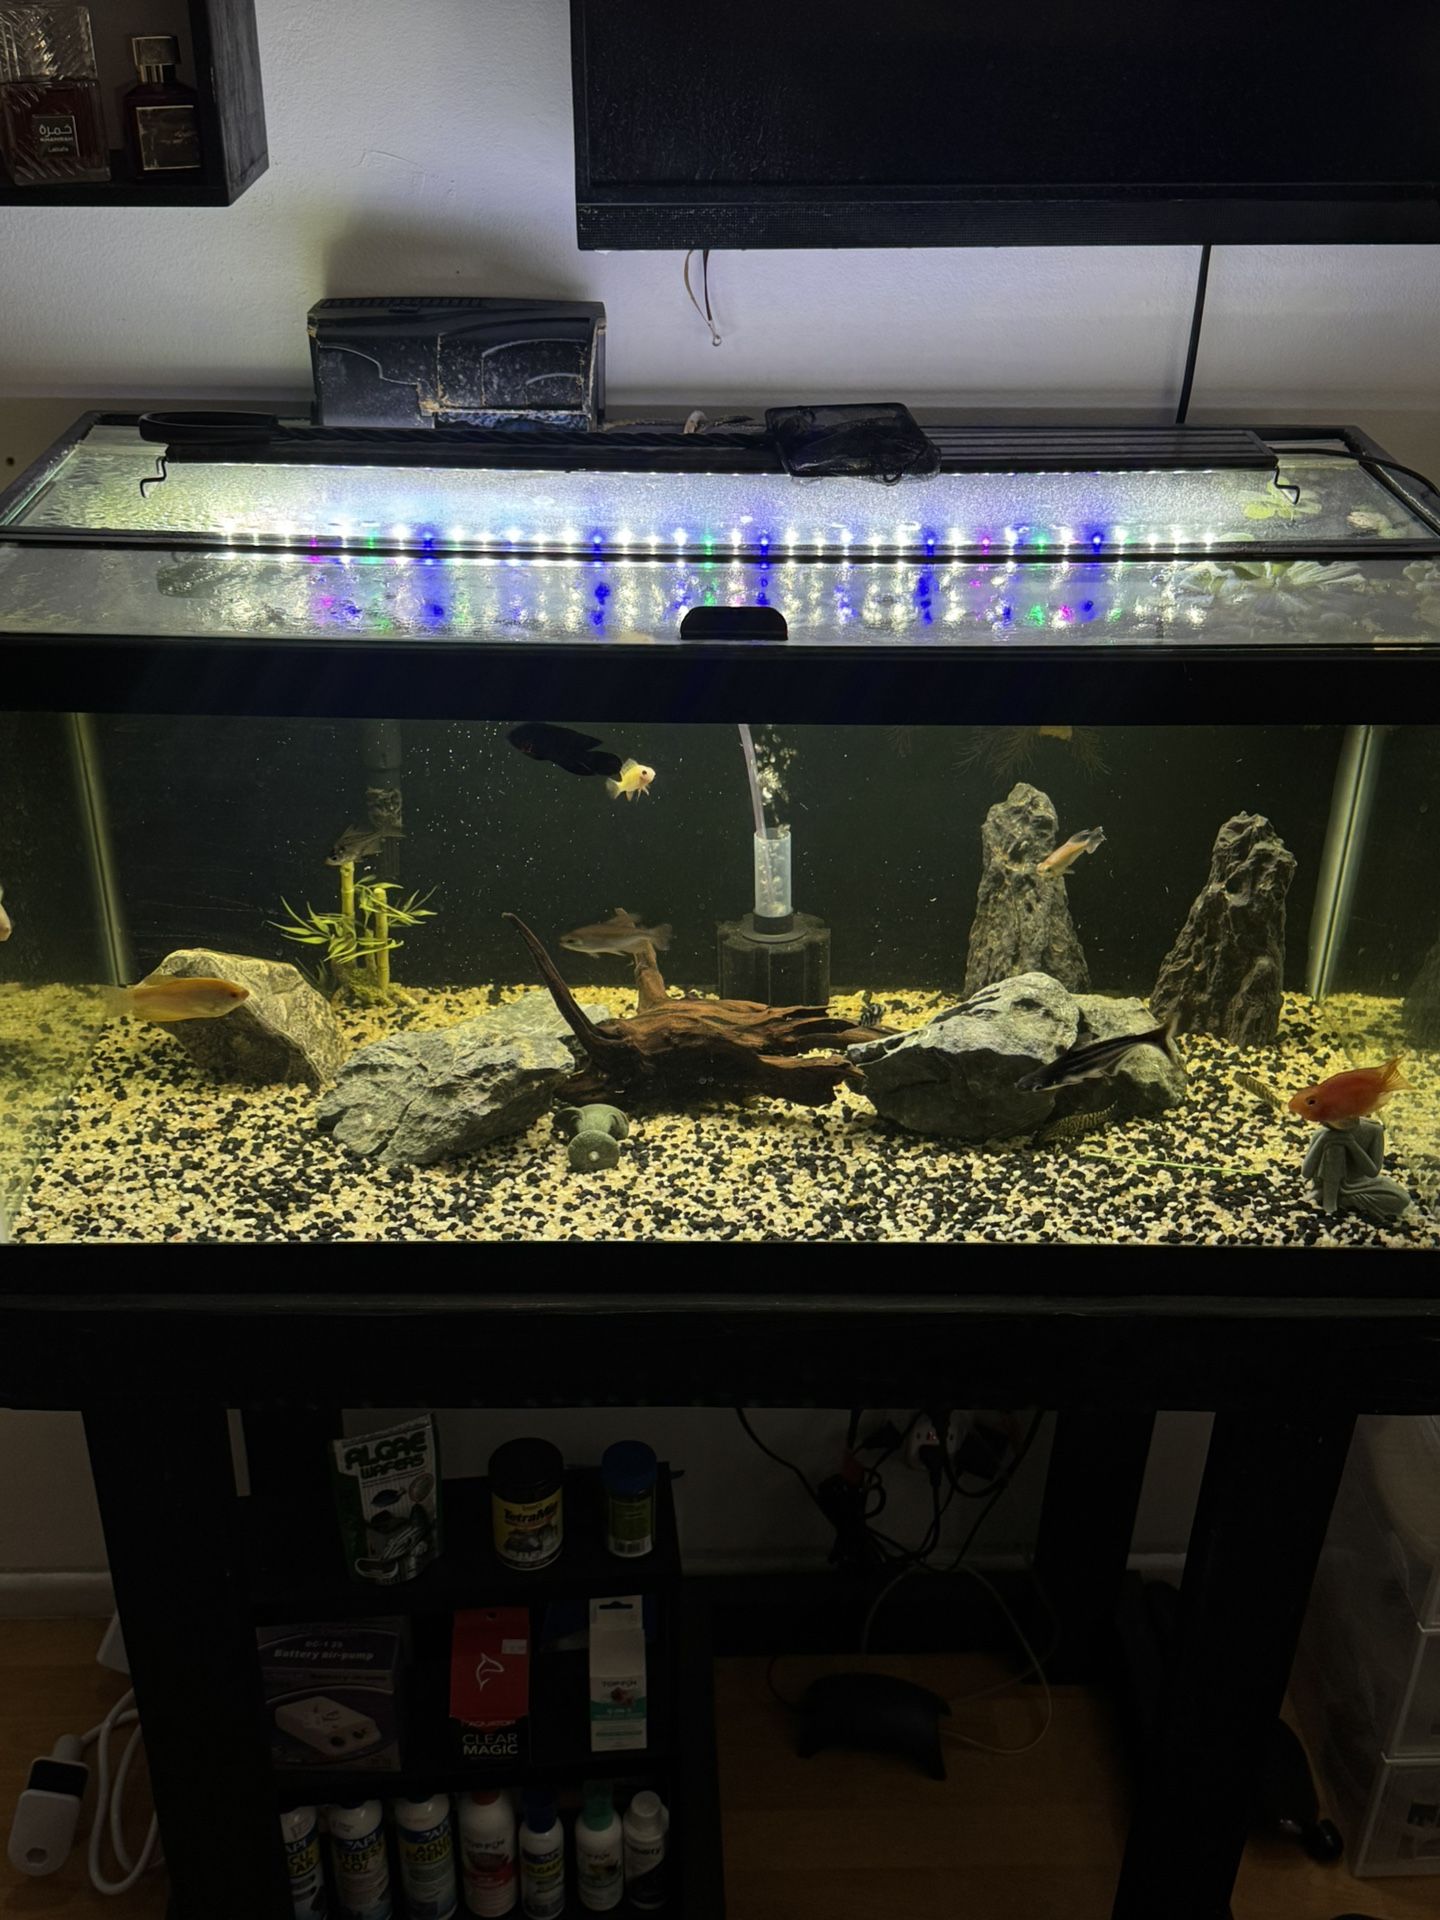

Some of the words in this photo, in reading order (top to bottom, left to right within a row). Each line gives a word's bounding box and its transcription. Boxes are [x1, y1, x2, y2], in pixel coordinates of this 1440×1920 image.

[344, 1431, 427, 1470] ALGAE
[360, 1454, 424, 1479] WAFERS
[273, 1648, 320, 1660] Battery
[462, 1733, 519, 1745] CLEAR
[463, 1743, 519, 1756] MAGIC
[351, 1832, 377, 1850] API
